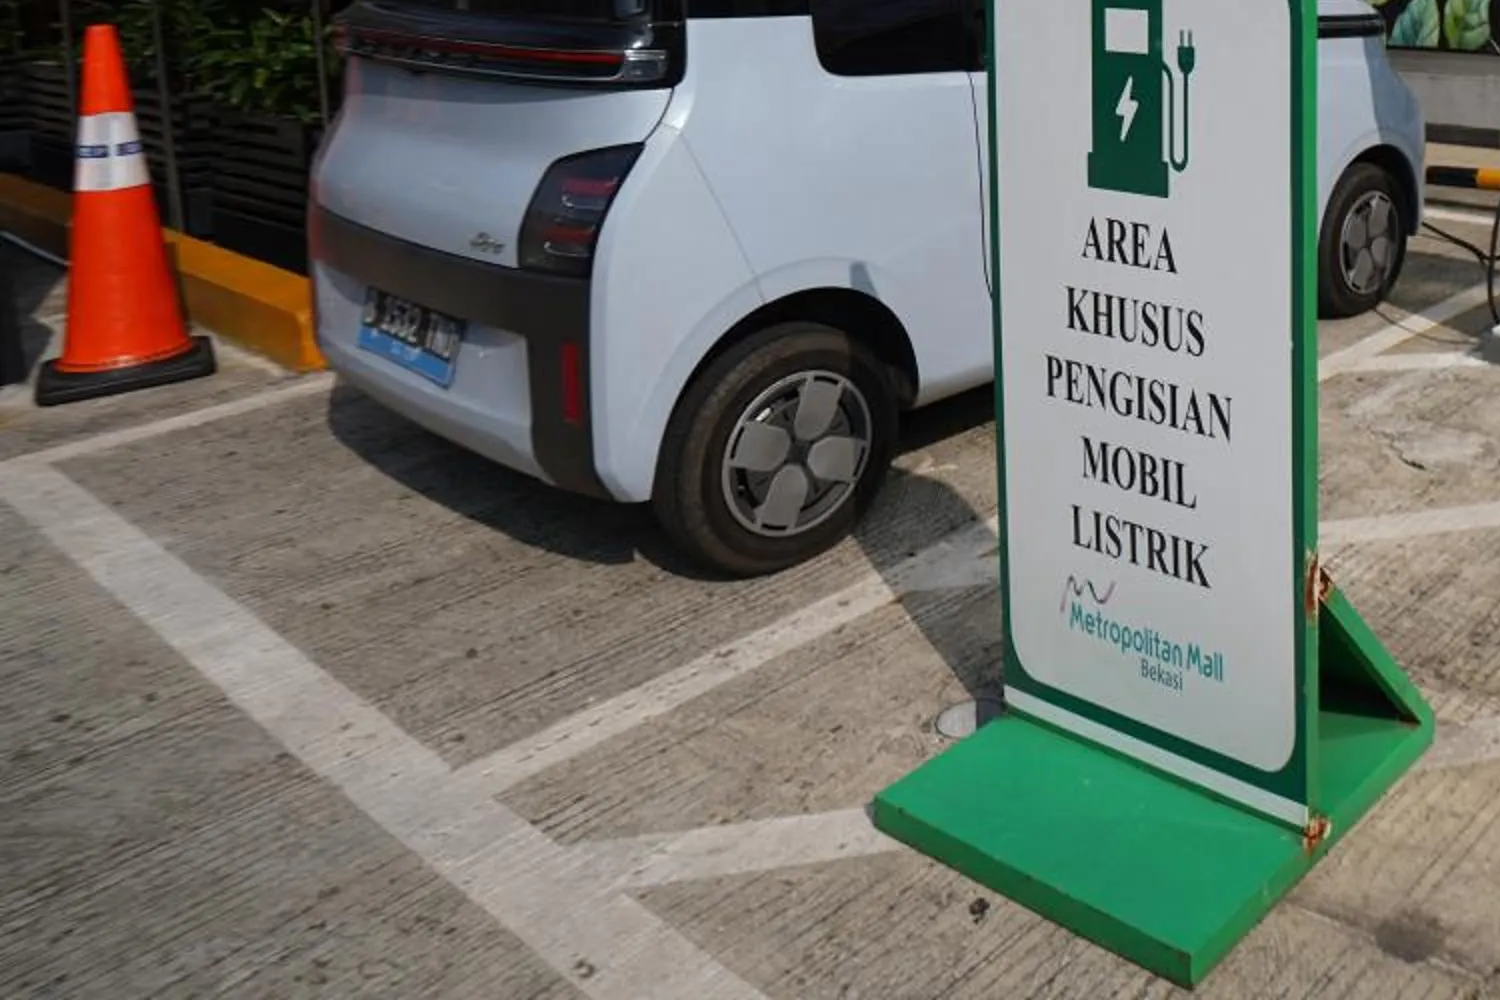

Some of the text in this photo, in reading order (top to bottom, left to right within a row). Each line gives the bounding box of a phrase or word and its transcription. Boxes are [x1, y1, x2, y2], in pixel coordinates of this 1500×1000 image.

[1082, 217, 1178, 274] AREA
[1065, 286, 1206, 357] KHUSUS
[1046, 354, 1233, 444] PENGISIAN
[1082, 436, 1198, 509] MOBIL
[1071, 505, 1212, 589] LISTRIK
[1070, 601, 1225, 682] Metropolitan Mall
[1140, 659, 1184, 691] Bekasi
